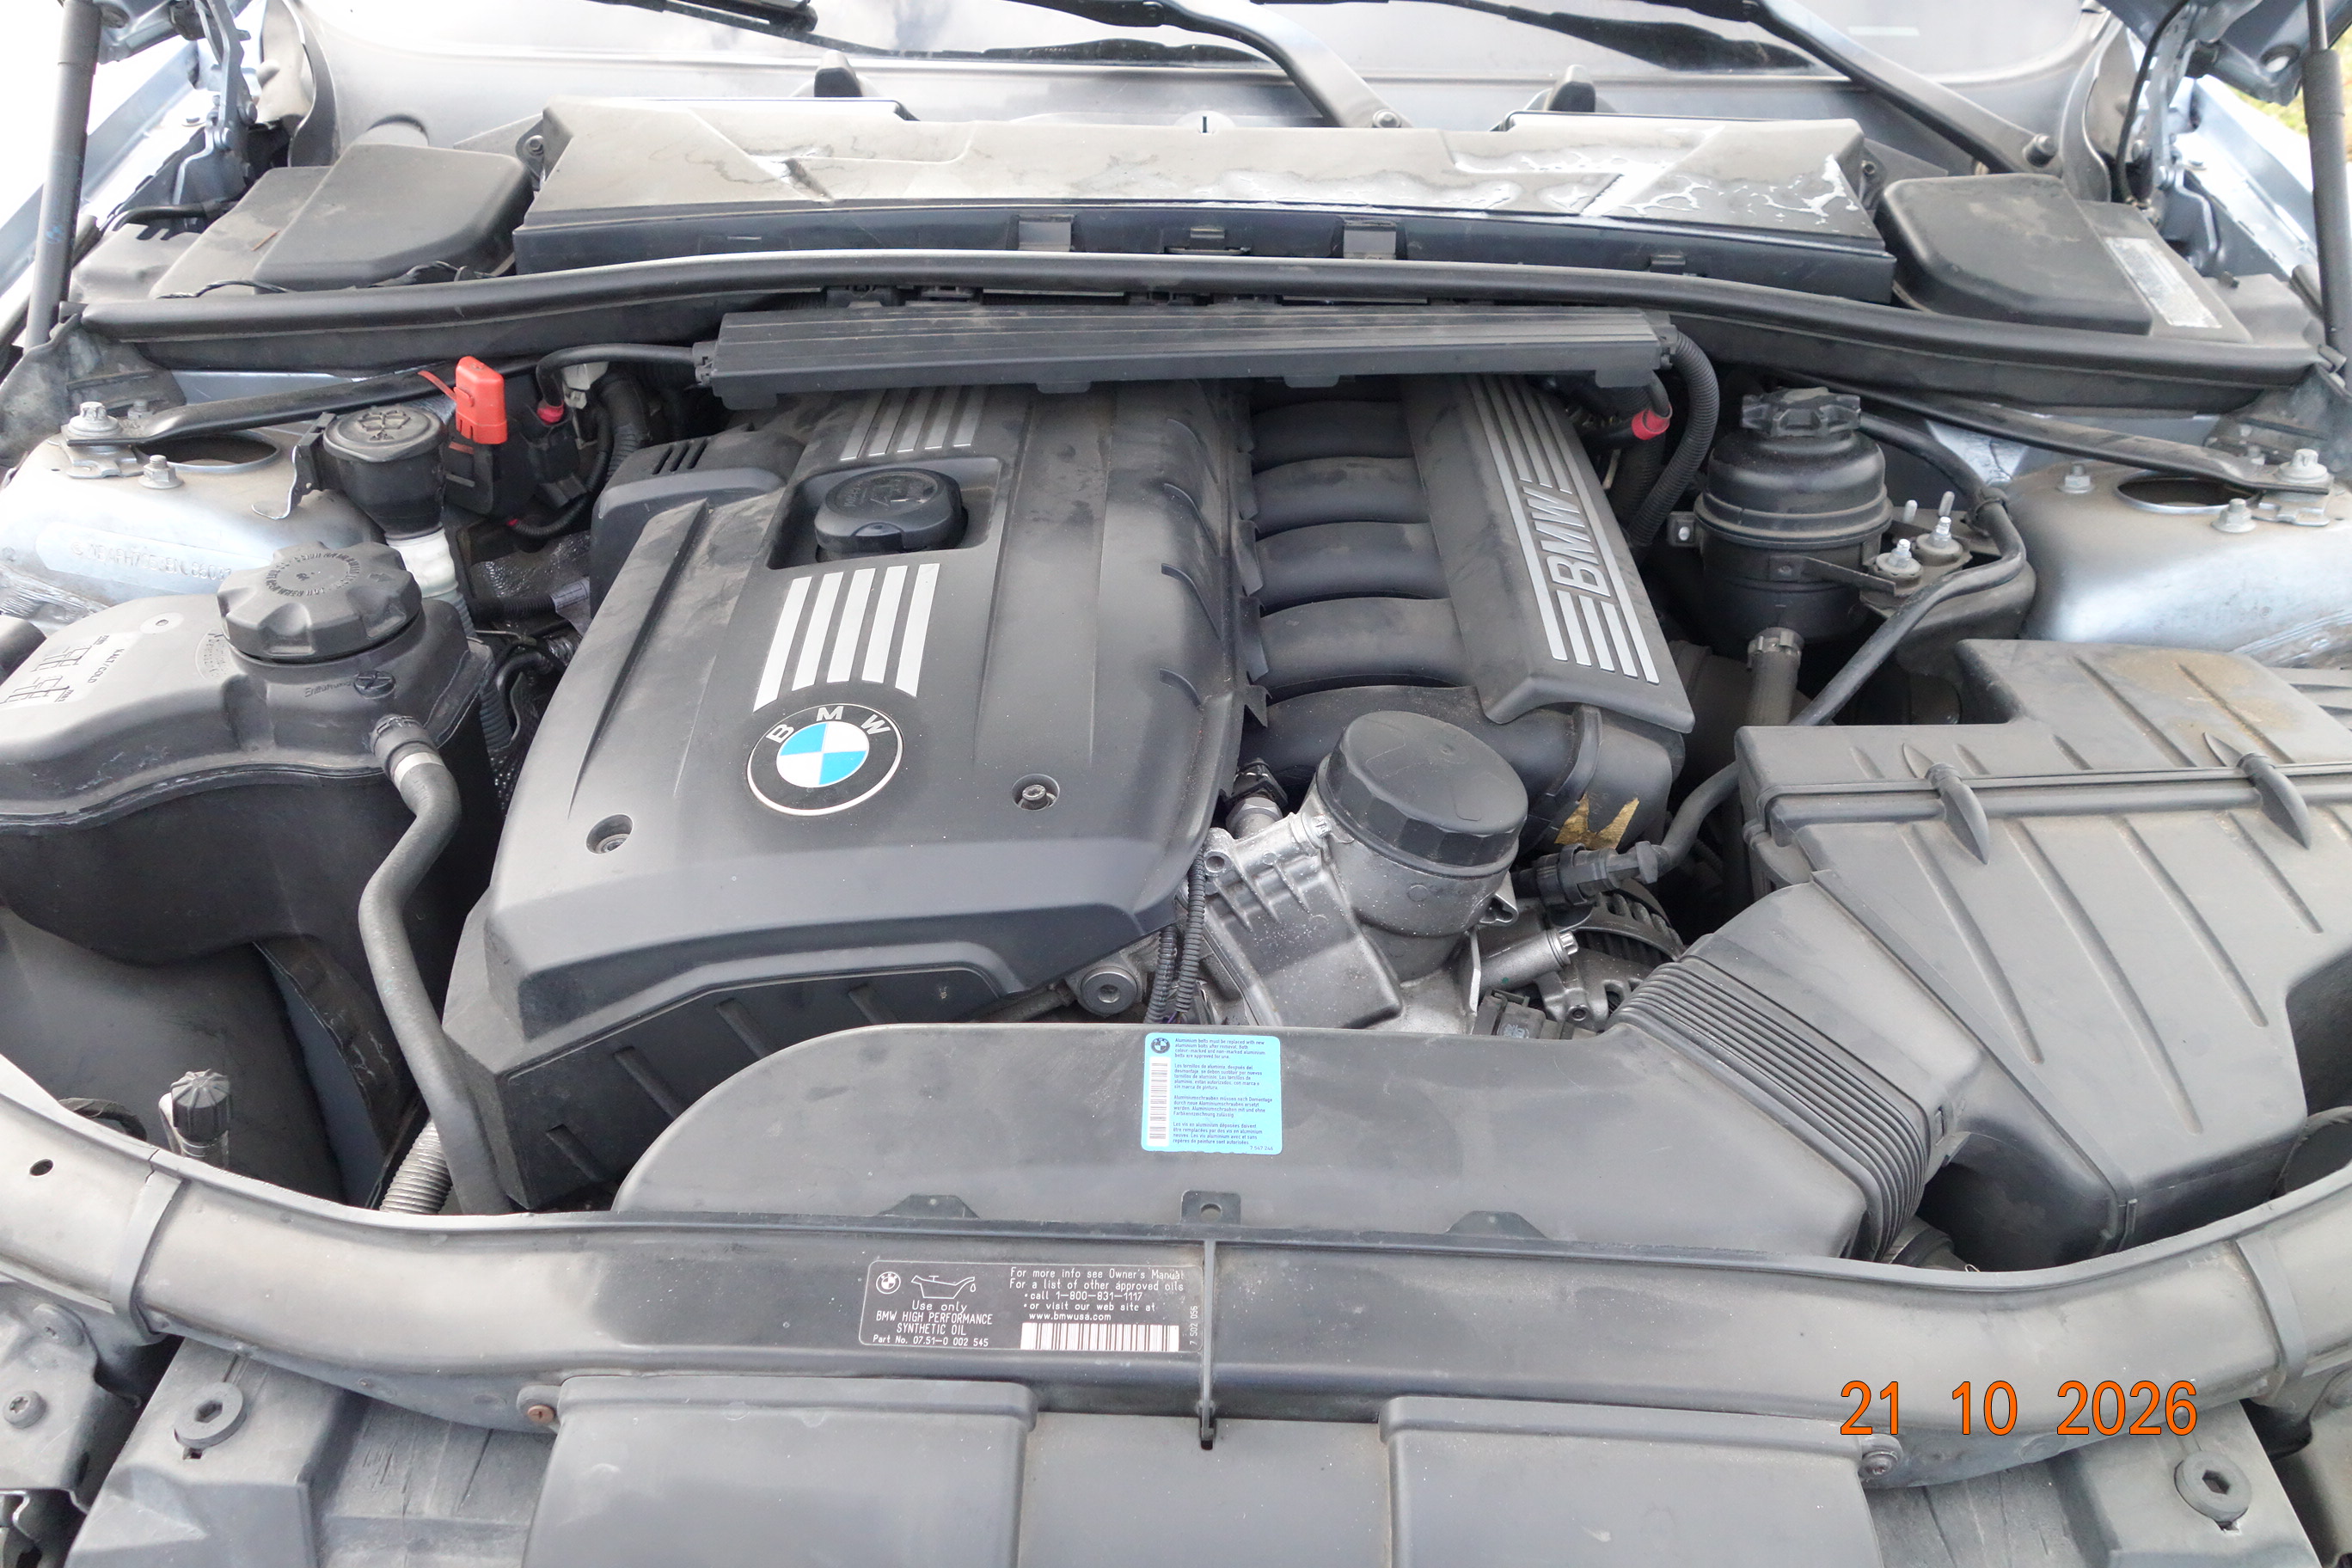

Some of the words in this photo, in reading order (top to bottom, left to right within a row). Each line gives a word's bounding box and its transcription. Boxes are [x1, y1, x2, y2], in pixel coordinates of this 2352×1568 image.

[1522, 486, 1611, 597] BMW
[766, 705, 891, 744] BMW
[1011, 1267, 1027, 1277] For
[1062, 1268, 1081, 1278] info
[1109, 1268, 1145, 1279] Owner's
[1152, 1269, 1184, 1280] Manual
[1009, 1278, 1026, 1289] For
[1044, 1278, 1061, 1289] list
[1067, 1279, 1078, 1289] of
[1084, 1279, 1109, 1290] other
[1116, 1280, 1159, 1292] approved
[1165, 1281, 1183, 1291] oils
[1030, 1291, 1049, 1300] call
[1055, 1291, 1143, 1301] 1-800-831-1117
[912, 1300, 932, 1311] Use
[941, 1301, 967, 1314] only
[1046, 1301, 1068, 1310] visit
[1096, 1302, 1114, 1311] web
[1120, 1303, 1139, 1312] site
[1146, 1302, 1155, 1312] at
[876, 1311, 897, 1321] BMW
[902, 1311, 924, 1322] HIGH
[929, 1312, 993, 1325] PERFORMANCE
[1029, 1311, 1111, 1321] www.bmwusa.com
[897, 1323, 946, 1334] SYNTHETIC
[951, 1325, 967, 1336] OIL
[873, 1334, 890, 1343] Part
[895, 1336, 908, 1344] No.
[953, 1337, 968, 1346] 002
[973, 1338, 989, 1347] 545
